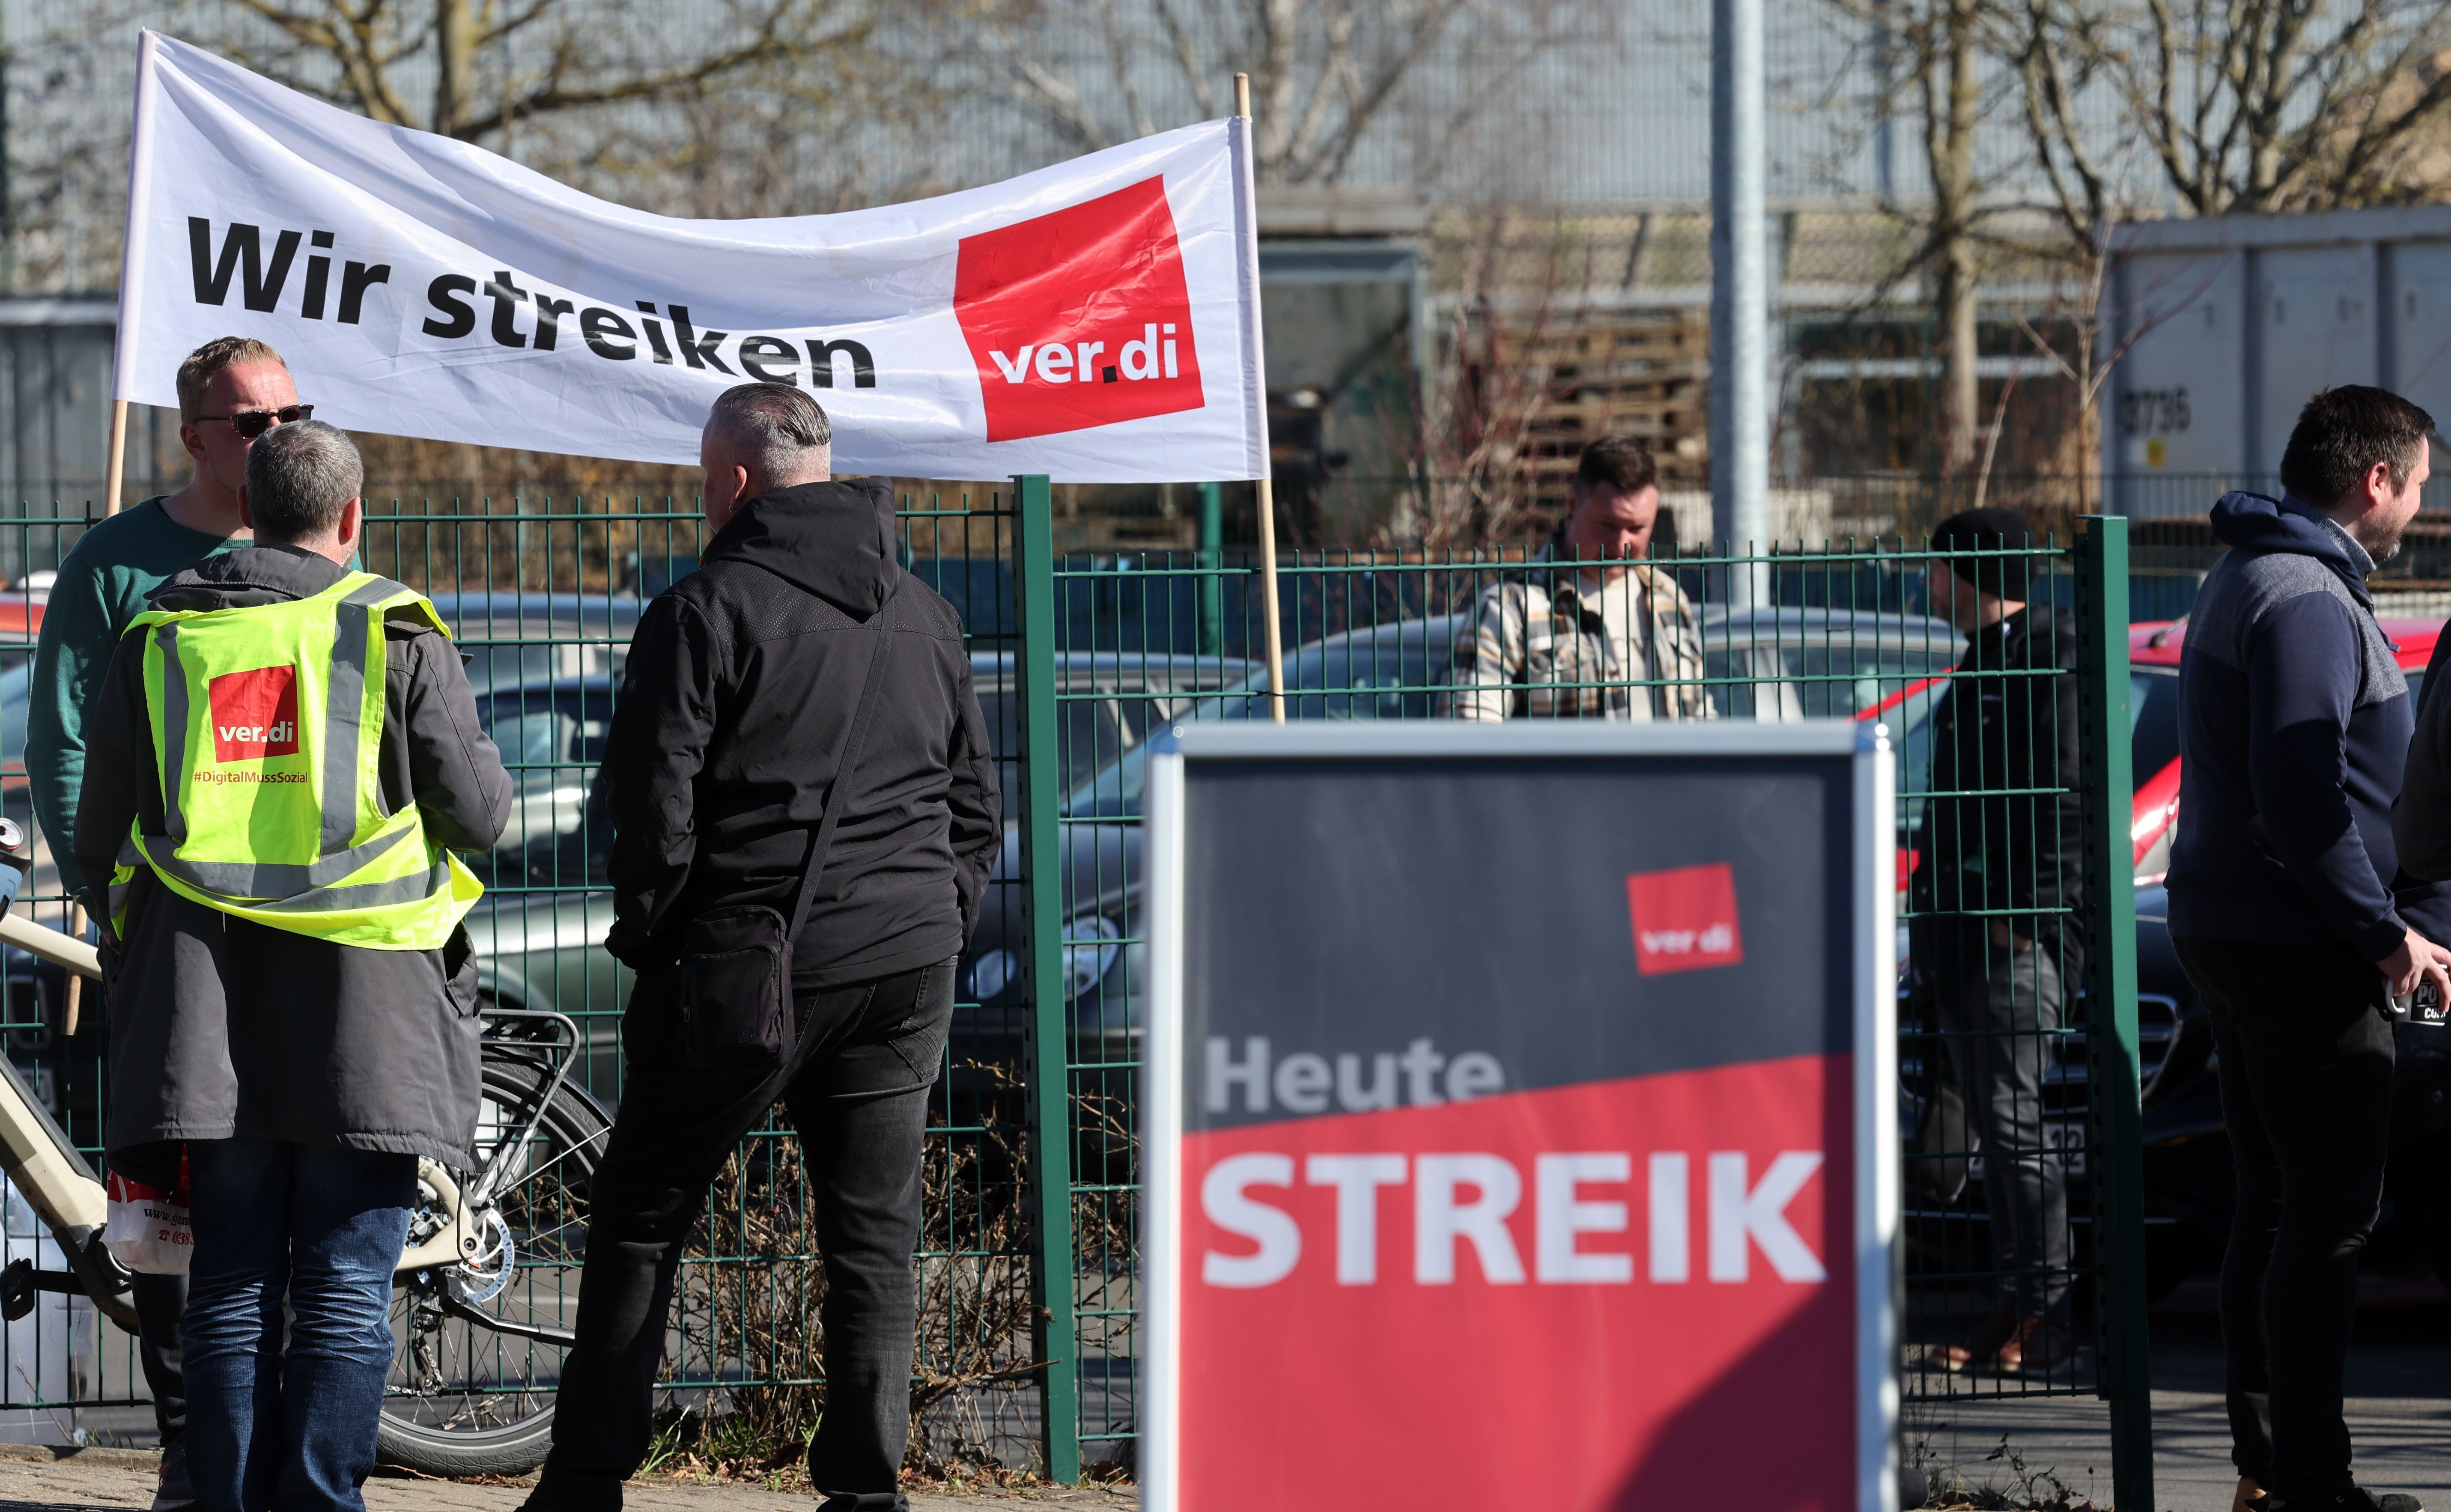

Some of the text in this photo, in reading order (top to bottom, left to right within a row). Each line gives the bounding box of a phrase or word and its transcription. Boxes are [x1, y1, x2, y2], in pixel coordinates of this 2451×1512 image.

[188, 217, 876, 390] Wir streiken
[989, 322, 1178, 384] ver.di
[218, 721, 293, 743] ver.di
[194, 771, 308, 785] #DigitalMussSozial
[1204, 1037, 1504, 1114] Heute
[1200, 1150, 1828, 1288] STREIK
